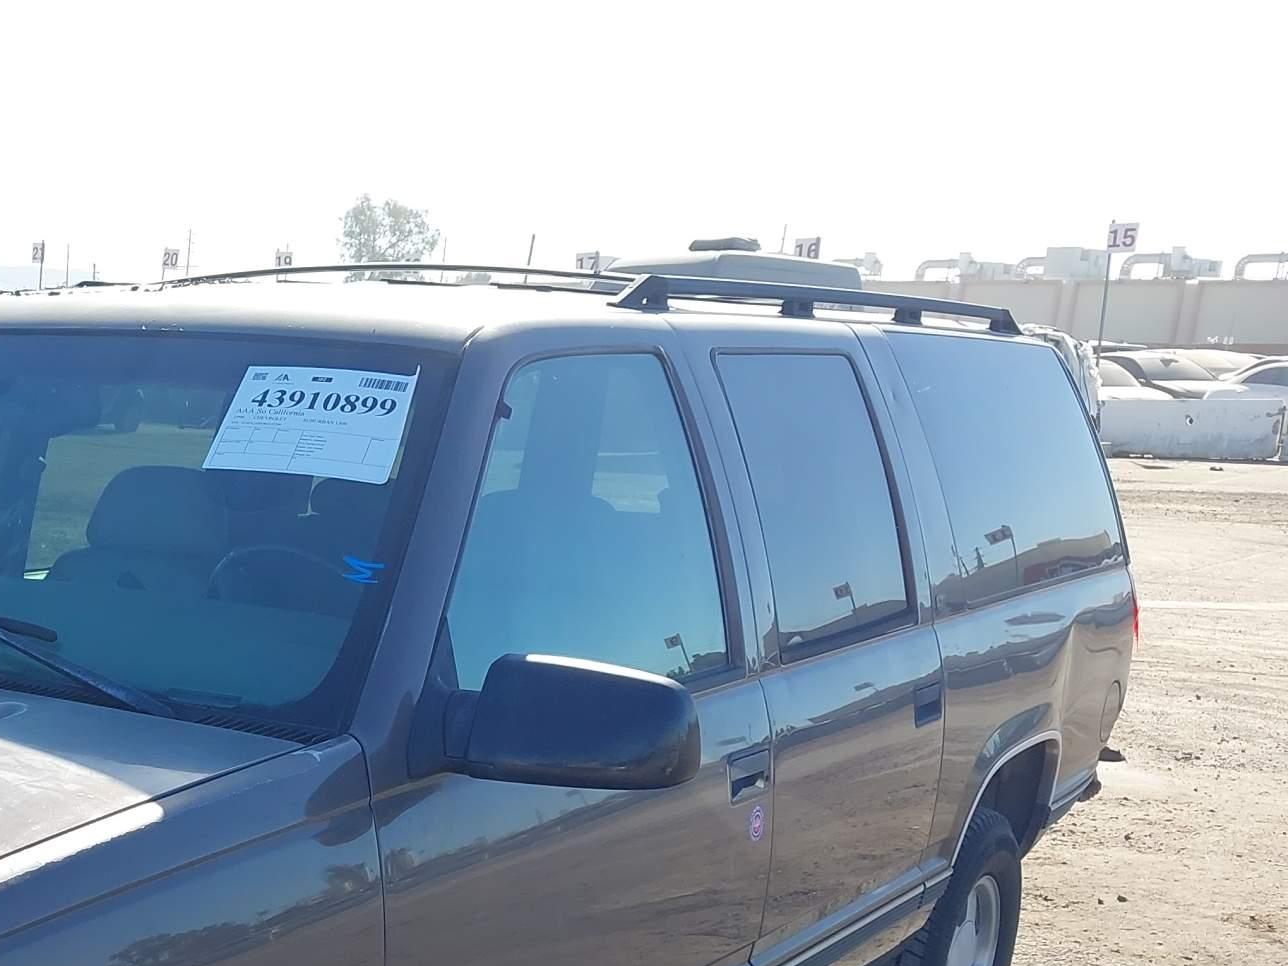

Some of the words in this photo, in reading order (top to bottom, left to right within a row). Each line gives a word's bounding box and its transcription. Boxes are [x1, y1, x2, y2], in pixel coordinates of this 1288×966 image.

[1107, 227, 1137, 248] 15
[163, 252, 178, 267] 20
[275, 255, 292, 267] 19
[577, 256, 598, 270] 17
[250, 388, 397, 417] 43910899
